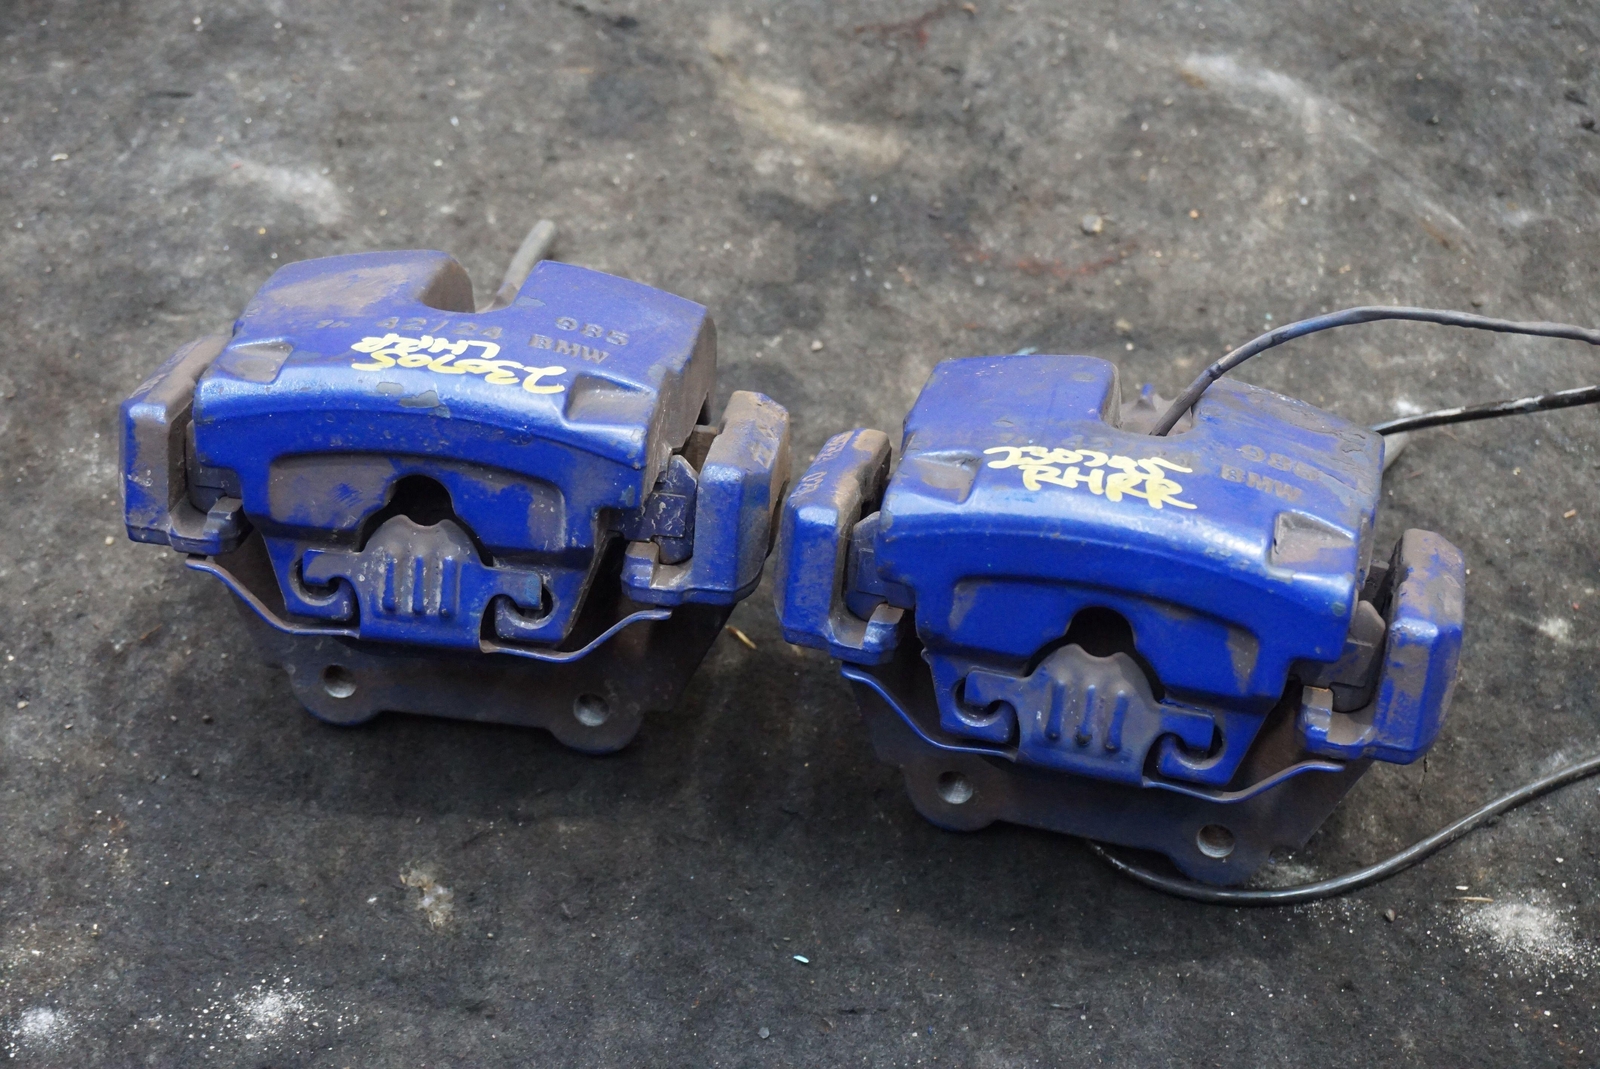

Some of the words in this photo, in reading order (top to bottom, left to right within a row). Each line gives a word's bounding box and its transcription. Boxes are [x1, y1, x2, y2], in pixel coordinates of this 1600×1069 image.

[528, 334, 610, 365] BMW
[1018, 464, 1198, 510] RHRR
[1220, 464, 1303, 502] BMW
